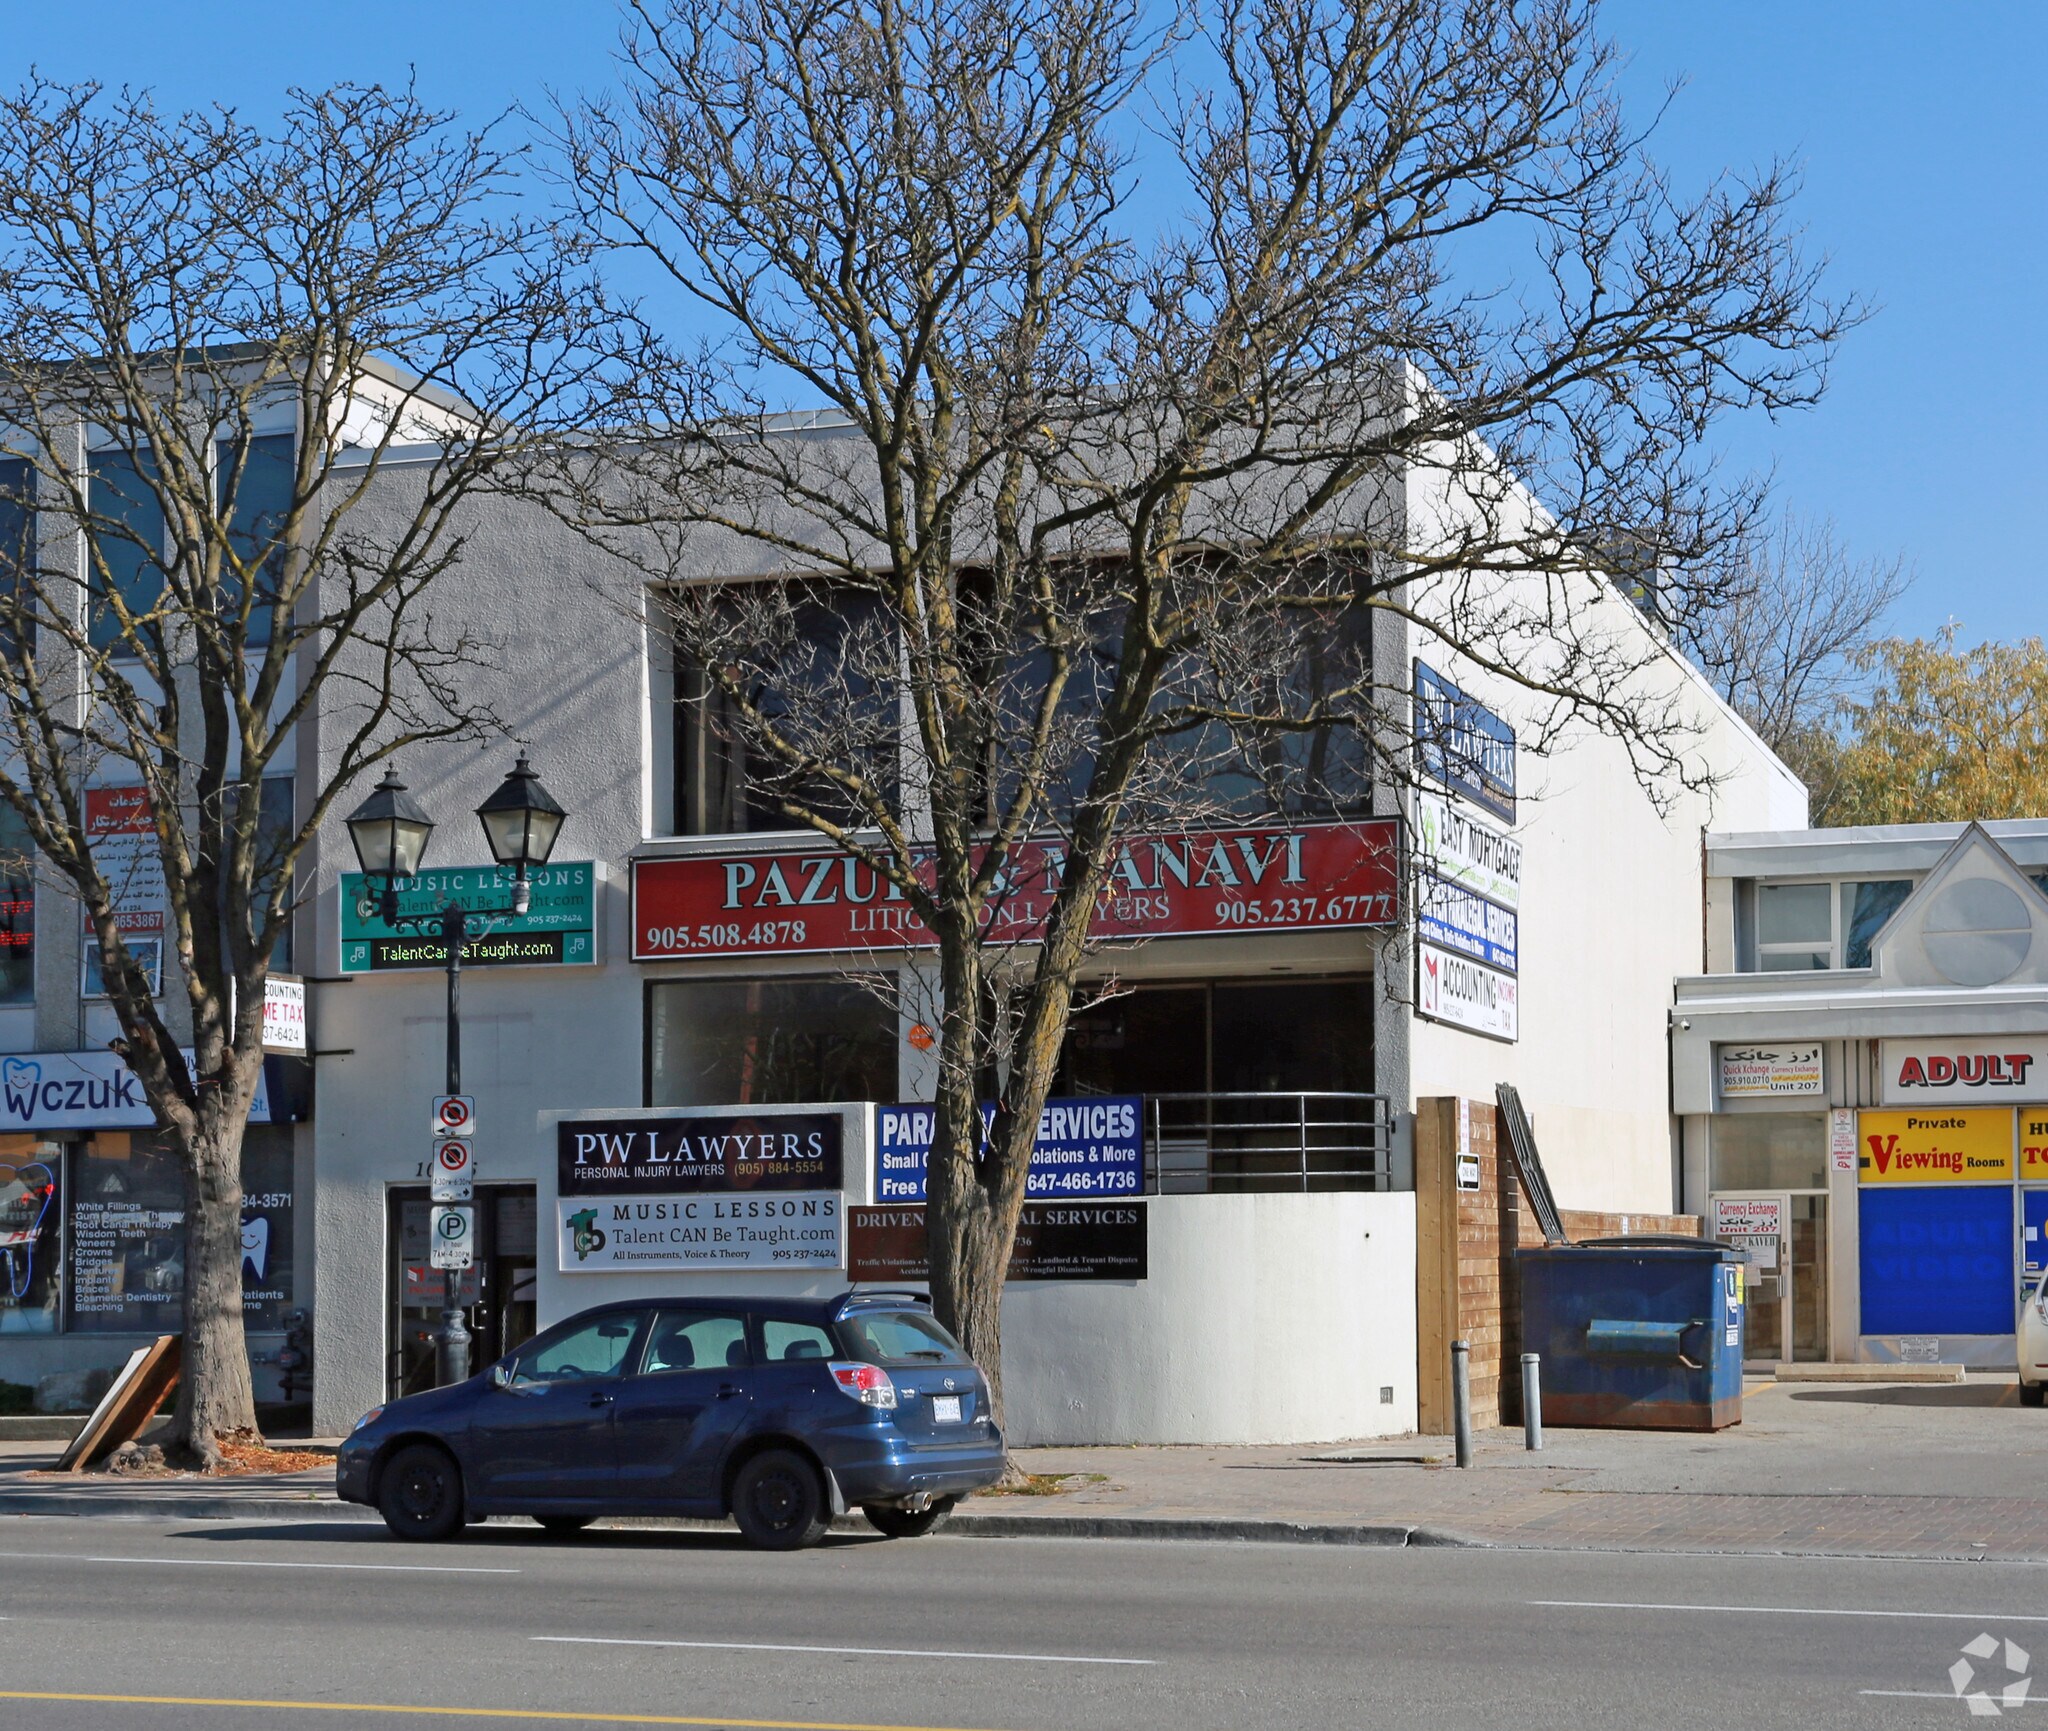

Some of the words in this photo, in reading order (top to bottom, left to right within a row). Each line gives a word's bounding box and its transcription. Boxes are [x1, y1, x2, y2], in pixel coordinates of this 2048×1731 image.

[1450, 700, 1515, 788] LAWYERS
[1440, 806, 1465, 855] EASY
[1469, 823, 1520, 884] MORTGAGE
[392, 873, 464, 892] MUSIC
[722, 852, 940, 909] PAZUK
[398, 897, 434, 912] alent
[477, 895, 494, 909] Be
[527, 915, 544, 926] 905
[545, 913, 583, 924] 237-2424
[647, 920, 806, 949] 905.508.4878
[1025, 896, 1170, 925] LYERS
[1215, 894, 1391, 925] 905.237.6777
[264, 983, 302, 1000] COUNTING
[1443, 957, 1497, 1010] ACCOUNTING
[1497, 978, 1515, 1005] INCOME
[282, 1003, 304, 1023] TAX
[1723, 1065, 1741, 1075] Quick
[1743, 1064, 1770, 1075] Xchange
[1771, 1066, 1794, 1074] Currency
[1795, 1065, 1819, 1074] Exchange
[1899, 1054, 2033, 1088] ADULT
[1723, 1075, 1770, 1085] 905.910.0710
[1770, 1083, 1794, 1091] Unit
[1797, 1082, 1818, 1090] 207
[1036, 1103, 1136, 1142] ERVICES
[1907, 1117, 1967, 1129] Private
[574, 1132, 637, 1165] PW
[646, 1131, 824, 1163] LAWYERS
[1867, 1134, 1964, 1174] Viewing
[1966, 1156, 2005, 1168] Rooms
[882, 1151, 919, 1170] Small
[1030, 1147, 1085, 1165] olations
[1088, 1146, 1099, 1163] &
[1102, 1145, 1136, 1163] More
[574, 1166, 631, 1180] PERSONAL
[634, 1164, 672, 1179] INJURY
[675, 1162, 725, 1177] LAWYERS
[734, 1162, 764, 1177] (905)
[768, 1160, 824, 1175] 884-5554
[882, 1178, 918, 1195] Free
[1027, 1171, 1136, 1191] 647-466-1736
[75, 1203, 104, 1211] White
[107, 1202, 142, 1211] Fillings
[613, 1202, 698, 1221] MUSIC
[714, 1199, 835, 1219] LESSONS
[1719, 1202, 1747, 1219] Currency
[1748, 1201, 1778, 1219] Exchange
[75, 1212, 99, 1220] Gum
[856, 1213, 924, 1229] DRIVEN
[1045, 1209, 1138, 1226] SERVICES
[75, 1221, 99, 1230] Root
[101, 1221, 130, 1229] Canal
[134, 1221, 173, 1230] Therapy
[75, 1230, 116, 1238] Wisdom
[119, 1229, 147, 1238] Teeth
[613, 1227, 665, 1245] Talent
[670, 1227, 706, 1243] CAN
[713, 1227, 732, 1242] Be
[737, 1225, 836, 1245] Taught.com
[75, 1258, 113, 1267] Bridges
[613, 1249, 625, 1260] All
[626, 1249, 682, 1261] Instruments,
[684, 1249, 708, 1259] Voice
[710, 1249, 718, 1258] &
[719, 1248, 750, 1260] Theory
[772, 1250, 791, 1260] 905
[793, 1248, 837, 1260] 237-2424
[856, 1258, 880, 1267] Traffic
[882, 1258, 917, 1266] Violations
[1038, 1256, 1071, 1265] Landlord
[1072, 1256, 1080, 1264] &
[1081, 1255, 1107, 1264] Tenant
[1107, 1255, 1138, 1265] Disputes
[75, 1267, 119, 1275] Dentures
[899, 1267, 929, 1276] Accident
[1022, 1266, 1056, 1275] Wrongful
[1057, 1265, 1094, 1274] Dismissals
[75, 1276, 118, 1285] Implants
[126, 1293, 172, 1303] Dentistry
[75, 1303, 124, 1312] Bleaching
